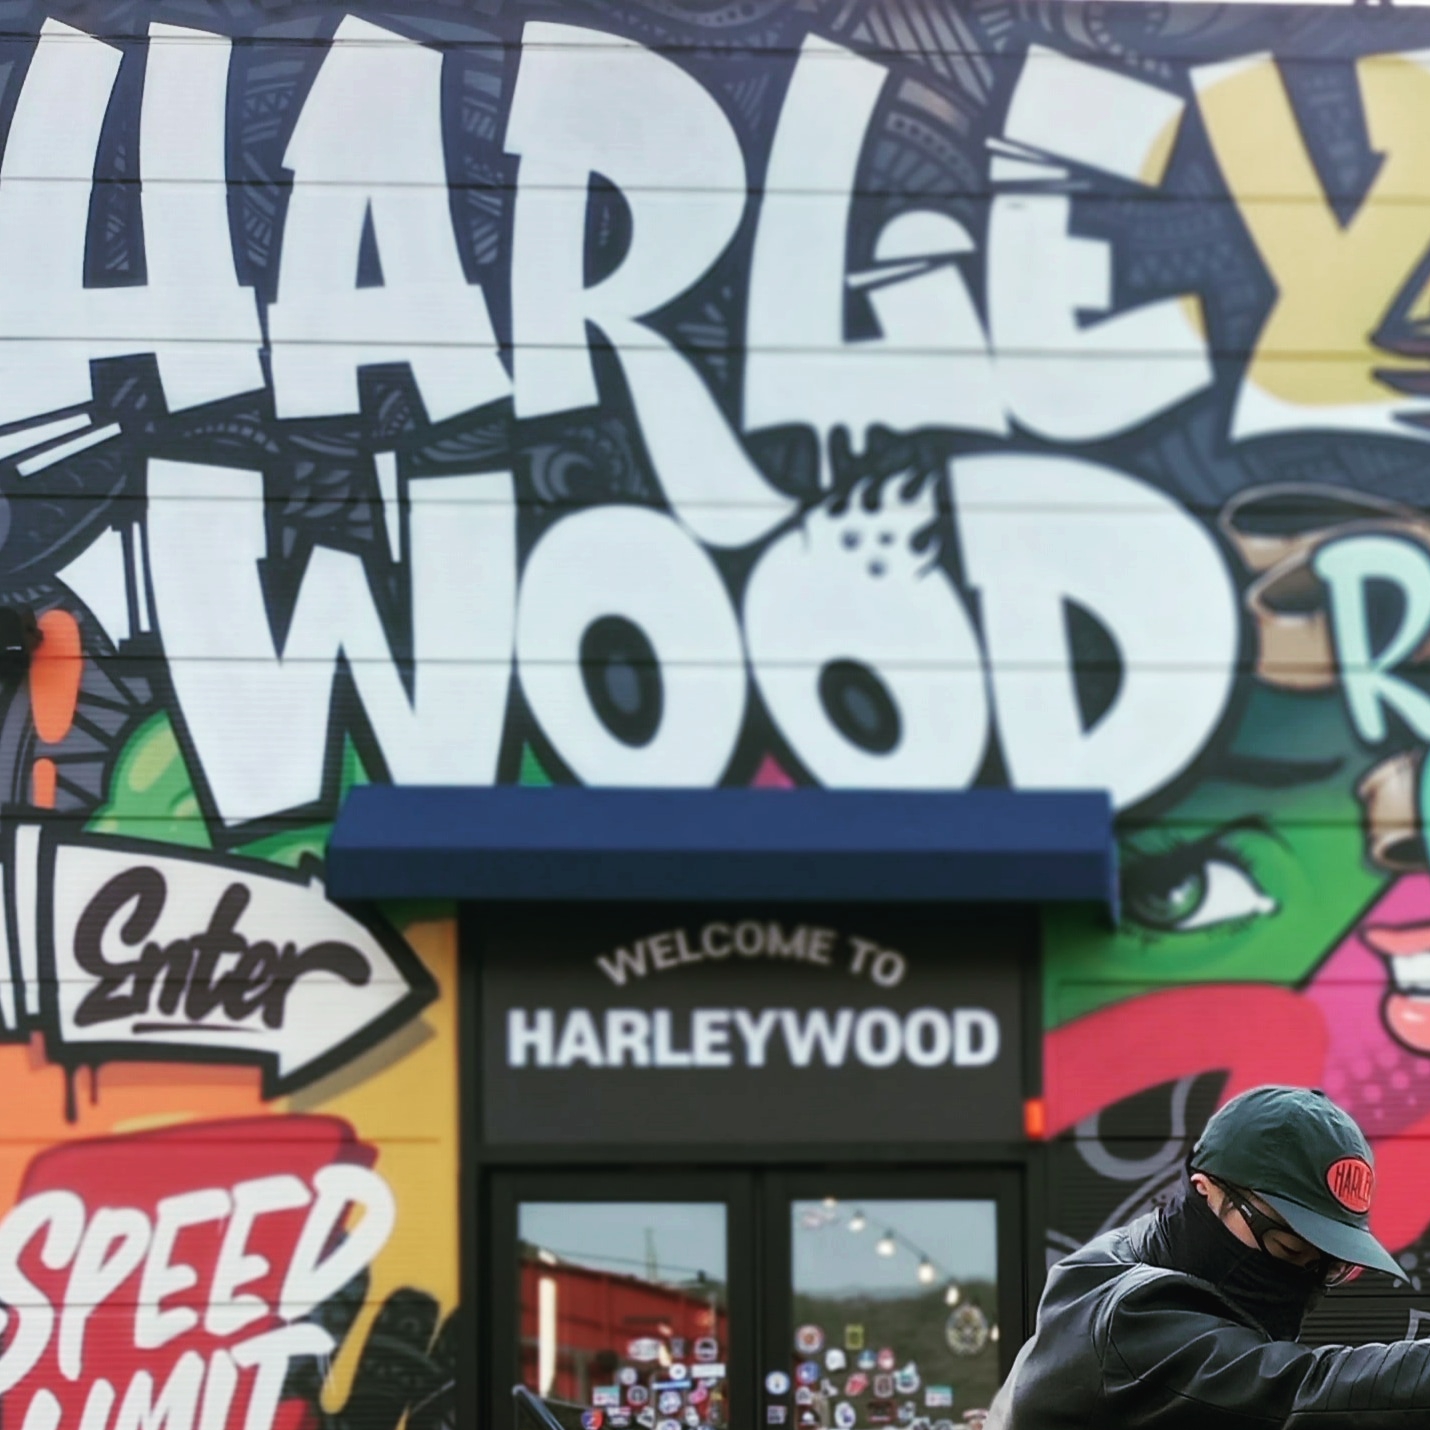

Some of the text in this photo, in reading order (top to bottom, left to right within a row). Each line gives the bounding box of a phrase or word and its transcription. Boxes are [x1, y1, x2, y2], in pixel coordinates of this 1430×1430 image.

[55, 446, 1240, 826] WOOD
[73, 865, 372, 1030] Enter
[596, 921, 906, 988] WELCOME TO
[507, 1007, 1000, 1068] HARLEYWOOD
[0, 1163, 396, 1396] SPEED
